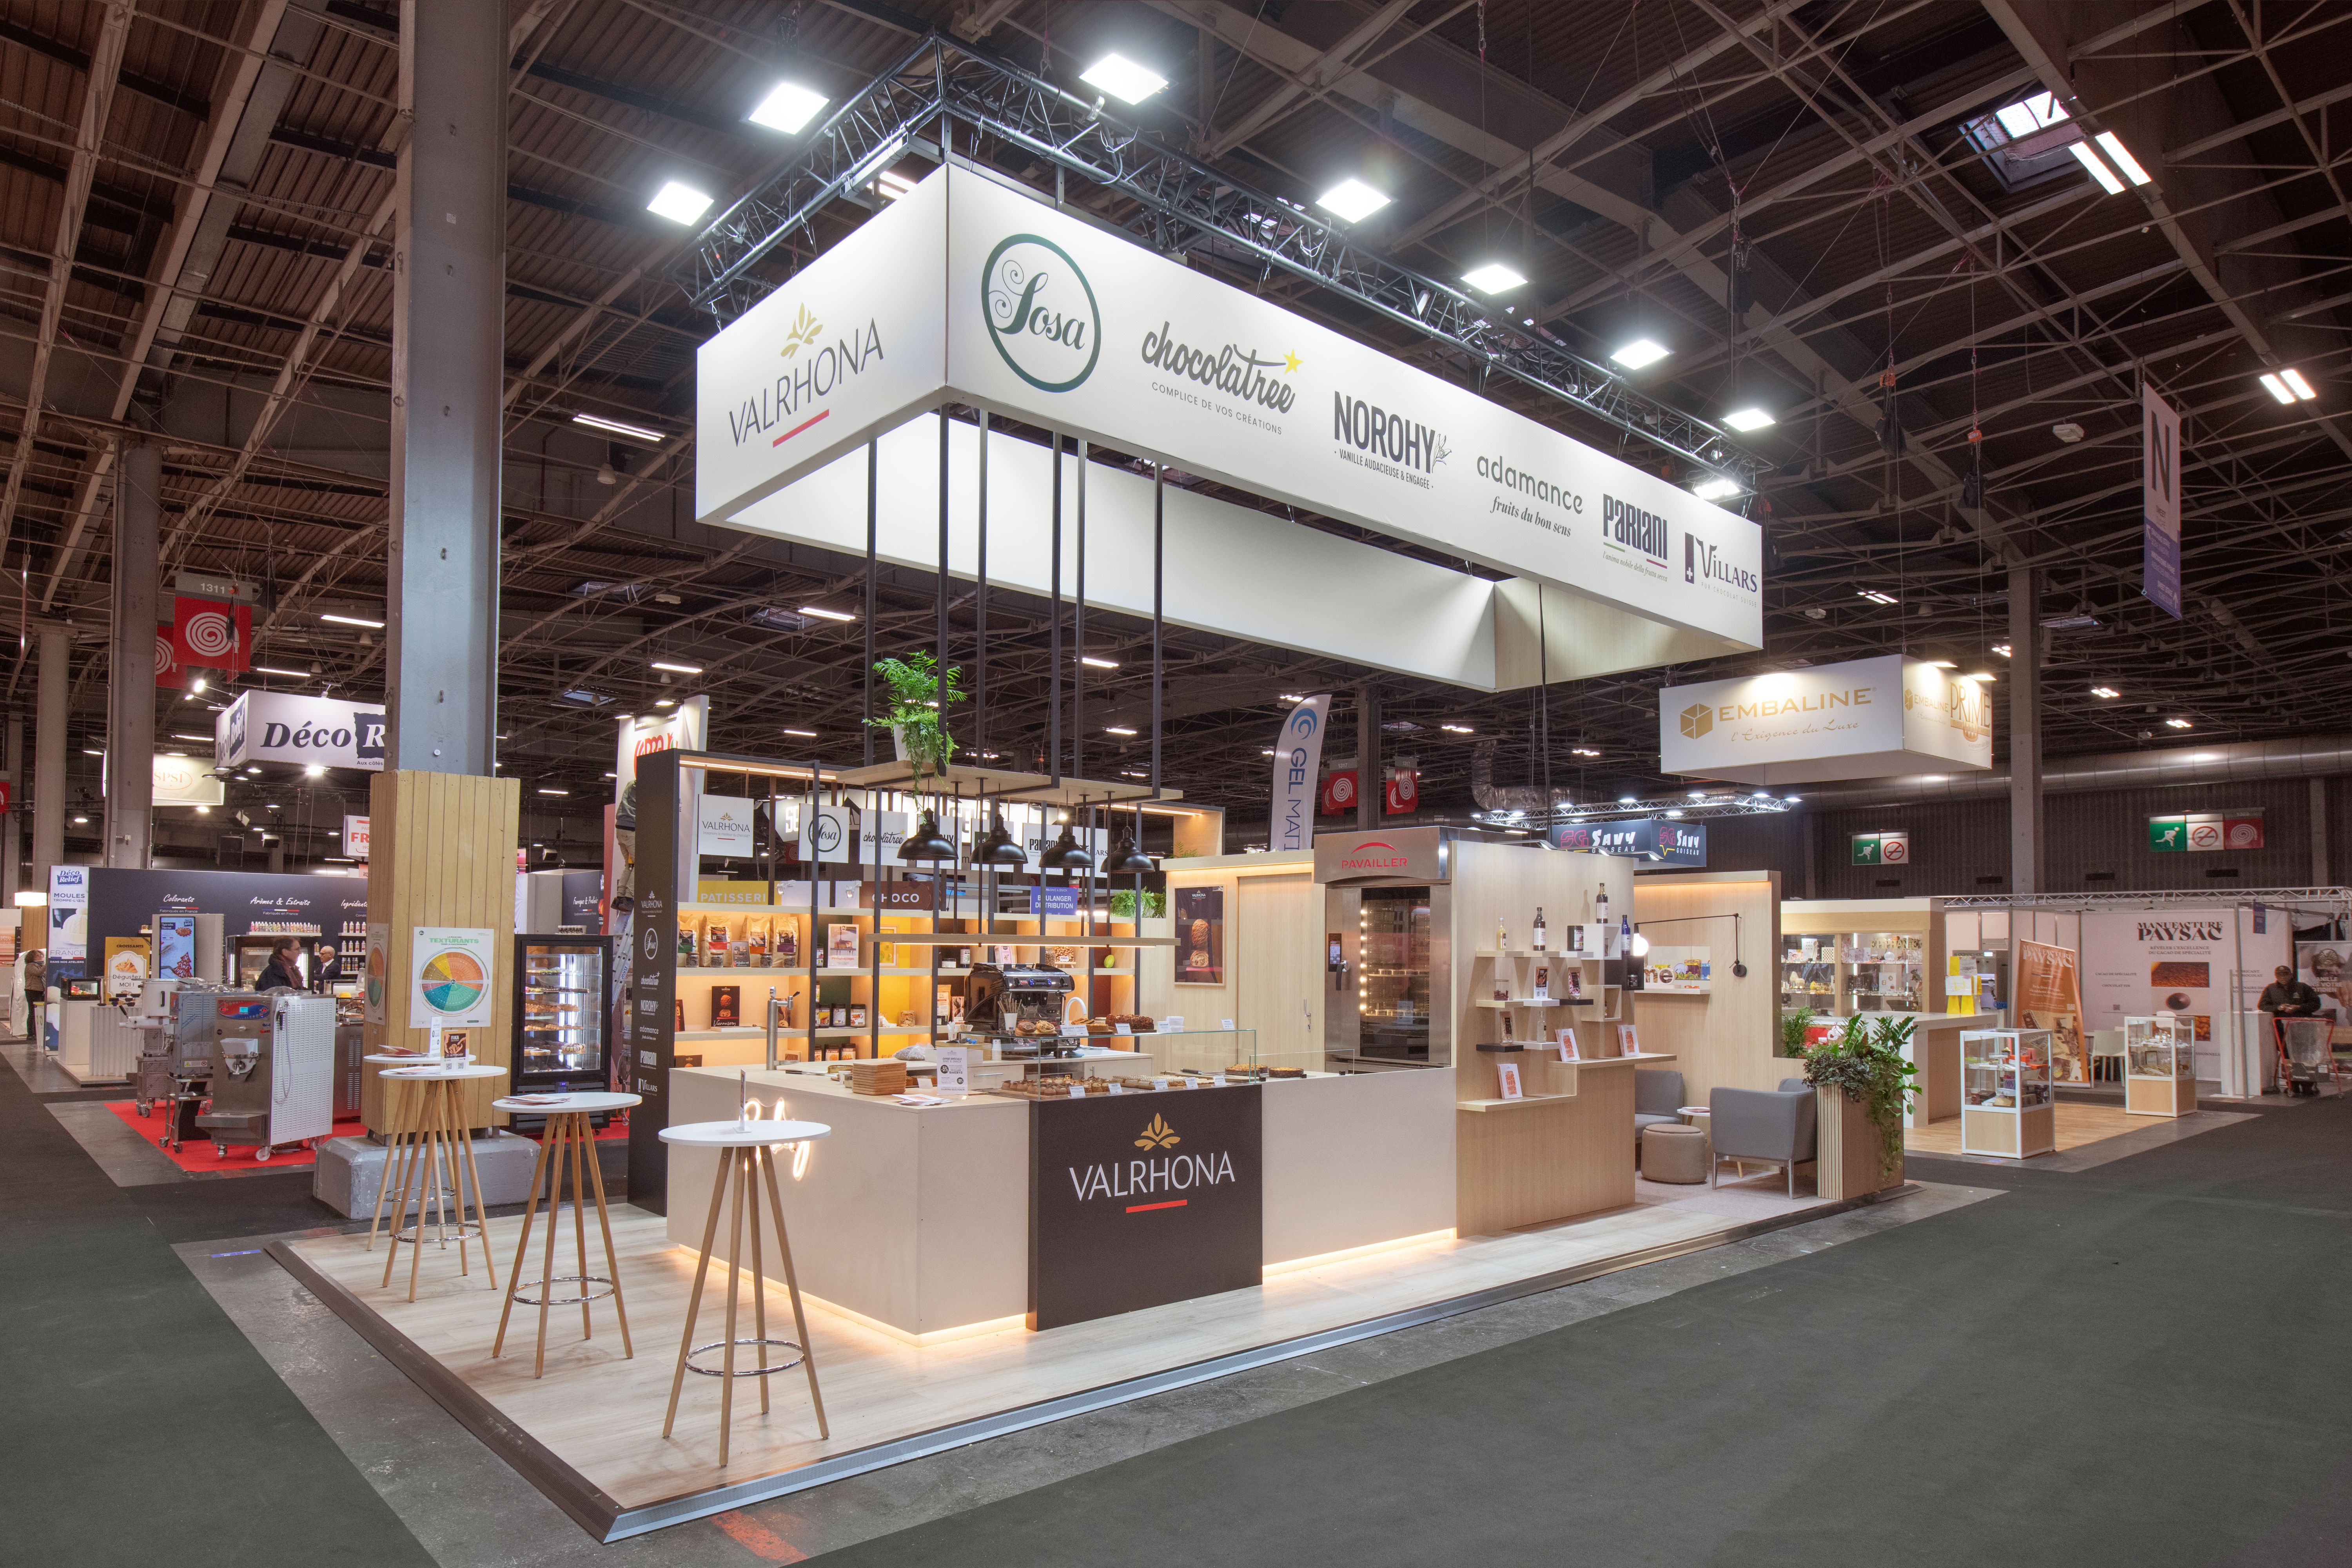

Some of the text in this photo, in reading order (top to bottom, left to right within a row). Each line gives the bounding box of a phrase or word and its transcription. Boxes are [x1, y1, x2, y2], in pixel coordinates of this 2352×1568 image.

[989, 260, 1085, 350] Sosa
[1141, 321, 1296, 414] chocolatree
[729, 317, 884, 448] VALRHONA
[1152, 381, 1282, 435] COMPLICE DE VOS CRÉATIONS
[1334, 390, 1436, 474] NOROHY
[1339, 448, 1430, 490] VANILLE AUDACIEUSE & ENGAGÉE
[2152, 410, 2170, 503] N
[1477, 455, 1583, 515] adamance
[1490, 496, 1571, 537] fruits du bon sens
[1603, 551, 1668, 582] l'anima nobile della frutta secca
[201, 583, 225, 593] 1311
[1701, 582, 1757, 608] PUR CHOCOLAT SUISSE
[1914, 694, 1949, 712] EMBALINE
[1950, 682, 1990, 728] PRIME
[260, 720, 352, 748] Déco
[1802, 724, 1819, 734] du
[1823, 719, 1859, 731] Luxe
[1288, 748, 1307, 794] GEL
[702, 821, 750, 832] VALRHONA
[864, 831, 904, 844] cholatree
[1341, 857, 1407, 869] PAVAILLER
[163, 894, 195, 902] Colorants
[250, 897, 274, 905] Arômes
[286, 897, 310, 906] Extraits
[701, 893, 766, 902] PATISSERI
[2137, 927, 2223, 940] PAYSAC
[641, 974, 659, 986] chocolatree
[641, 1000, 656, 1012] NOROHY
[640, 1026, 659, 1034] adamance
[1069, 1151, 1235, 1201] VALRHONA
